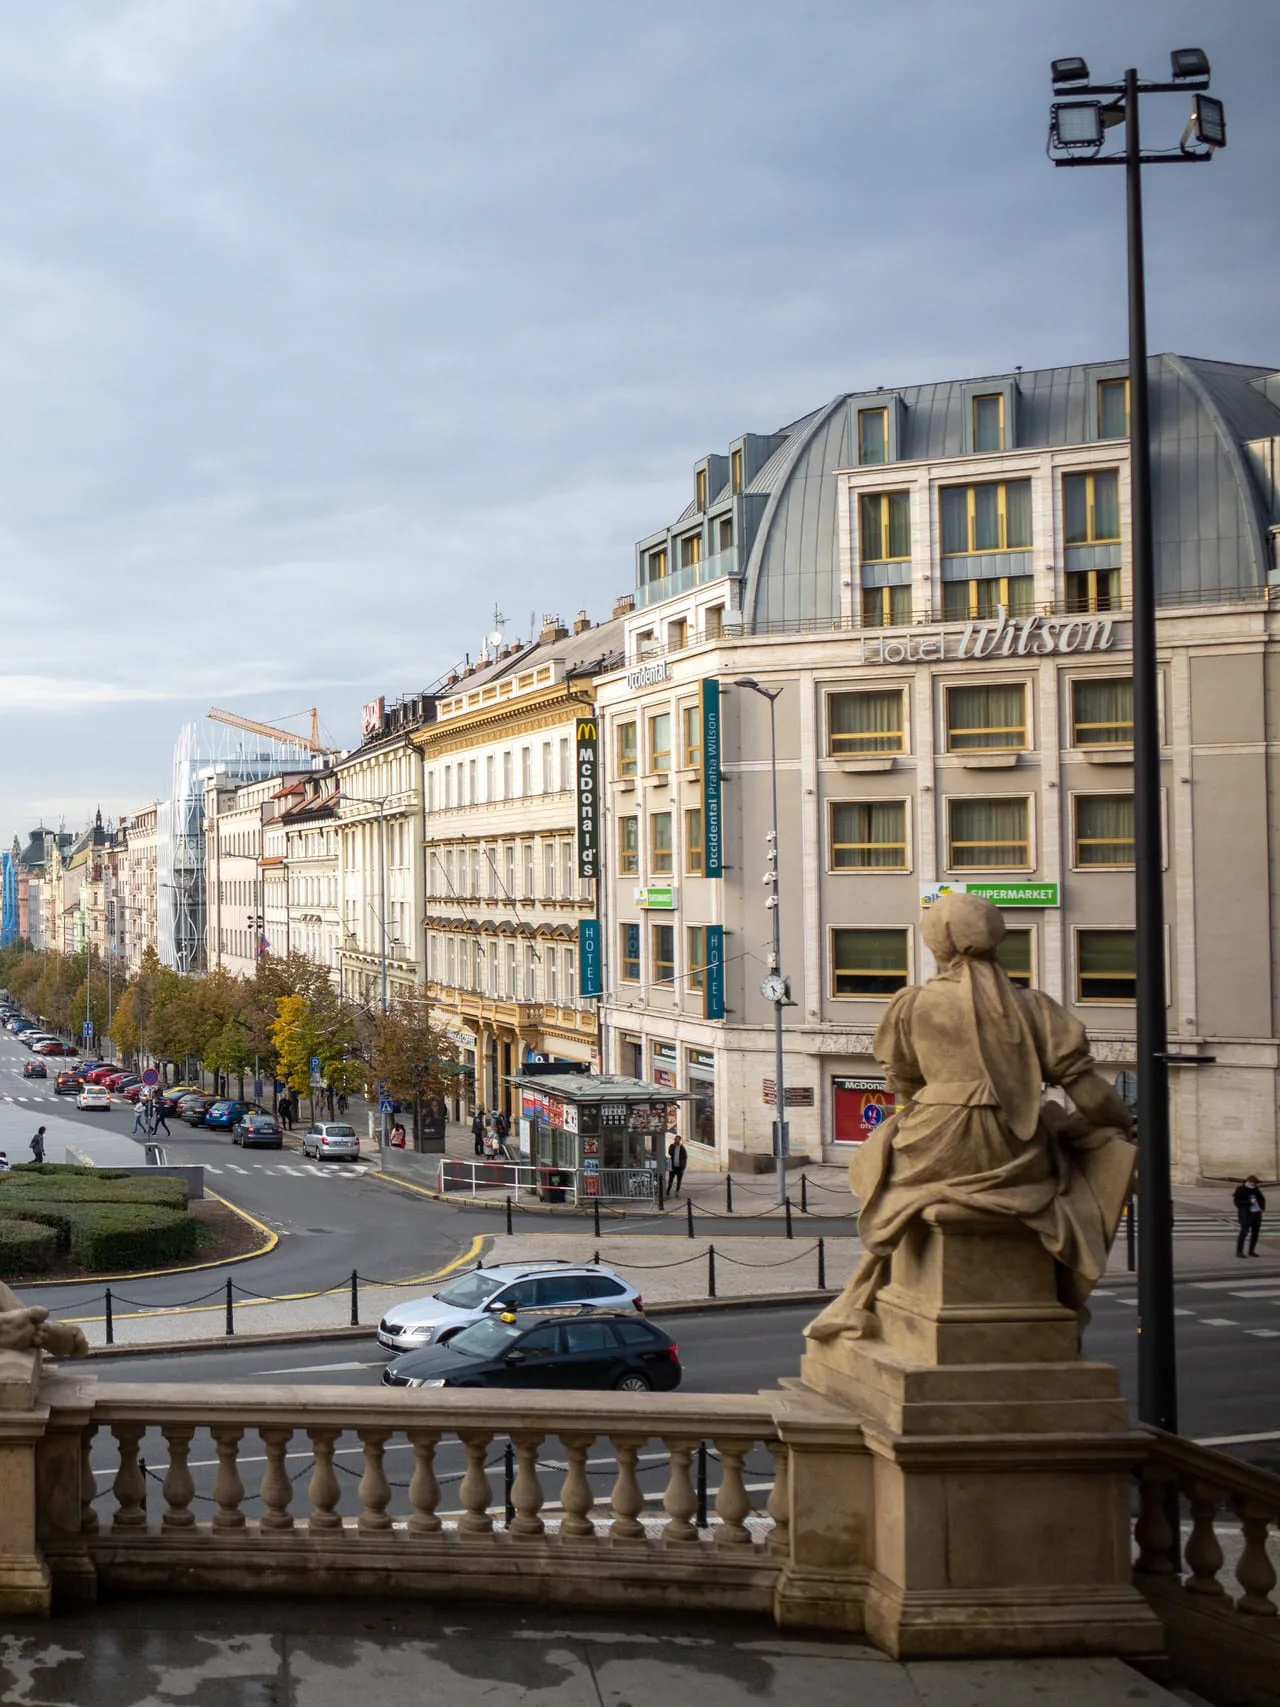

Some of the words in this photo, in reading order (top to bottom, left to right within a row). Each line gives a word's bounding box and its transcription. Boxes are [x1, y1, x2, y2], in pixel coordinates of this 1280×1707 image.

[956, 604, 1113, 659] Wilson
[707, 712, 717, 756] Wilson
[708, 759, 717, 795] Praha
[579, 748, 597, 876] McDonald's
[708, 798, 718, 868] Occidental
[585, 928, 594, 992] HOTEL
[711, 935, 719, 1011] HOTEL
[845, 1081, 885, 1090] McDona
